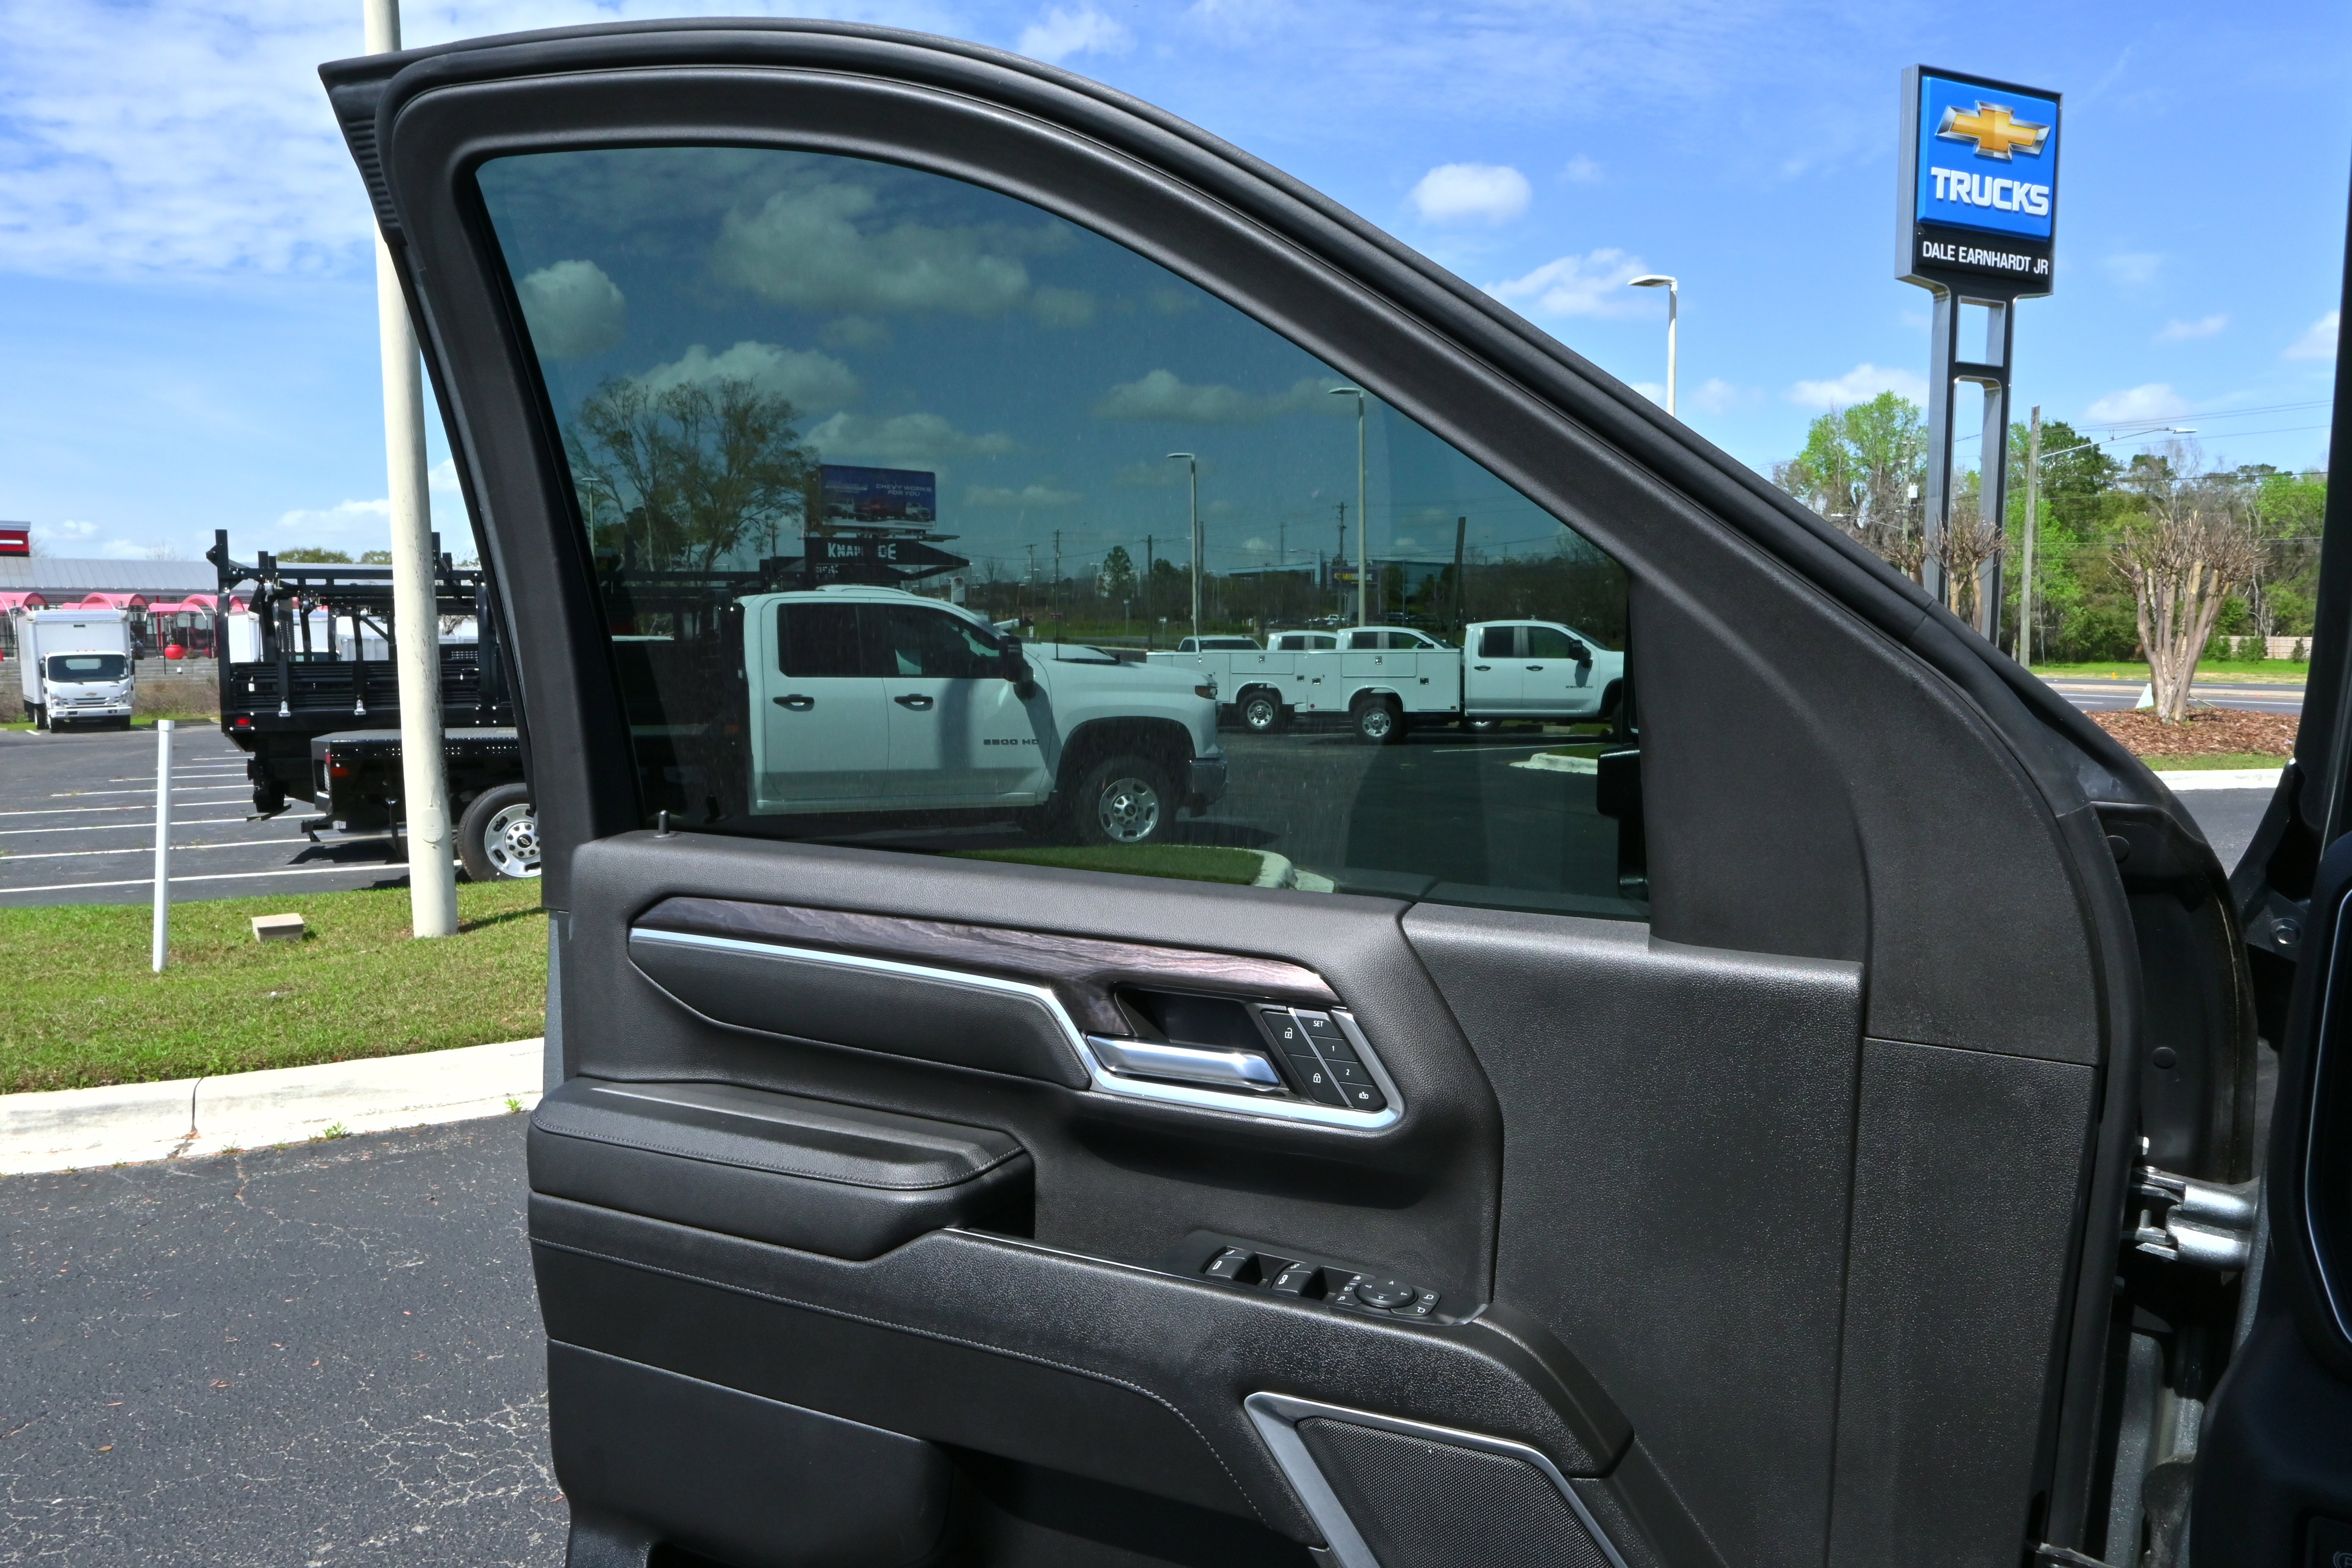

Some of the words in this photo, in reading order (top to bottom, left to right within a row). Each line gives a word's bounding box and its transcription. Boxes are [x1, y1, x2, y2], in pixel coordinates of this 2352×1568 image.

[1930, 167, 2050, 216] TRUCKS
[1922, 241, 1955, 261] DALE
[1959, 246, 2031, 272] EARNHARDT
[2034, 259, 2048, 275] JR
